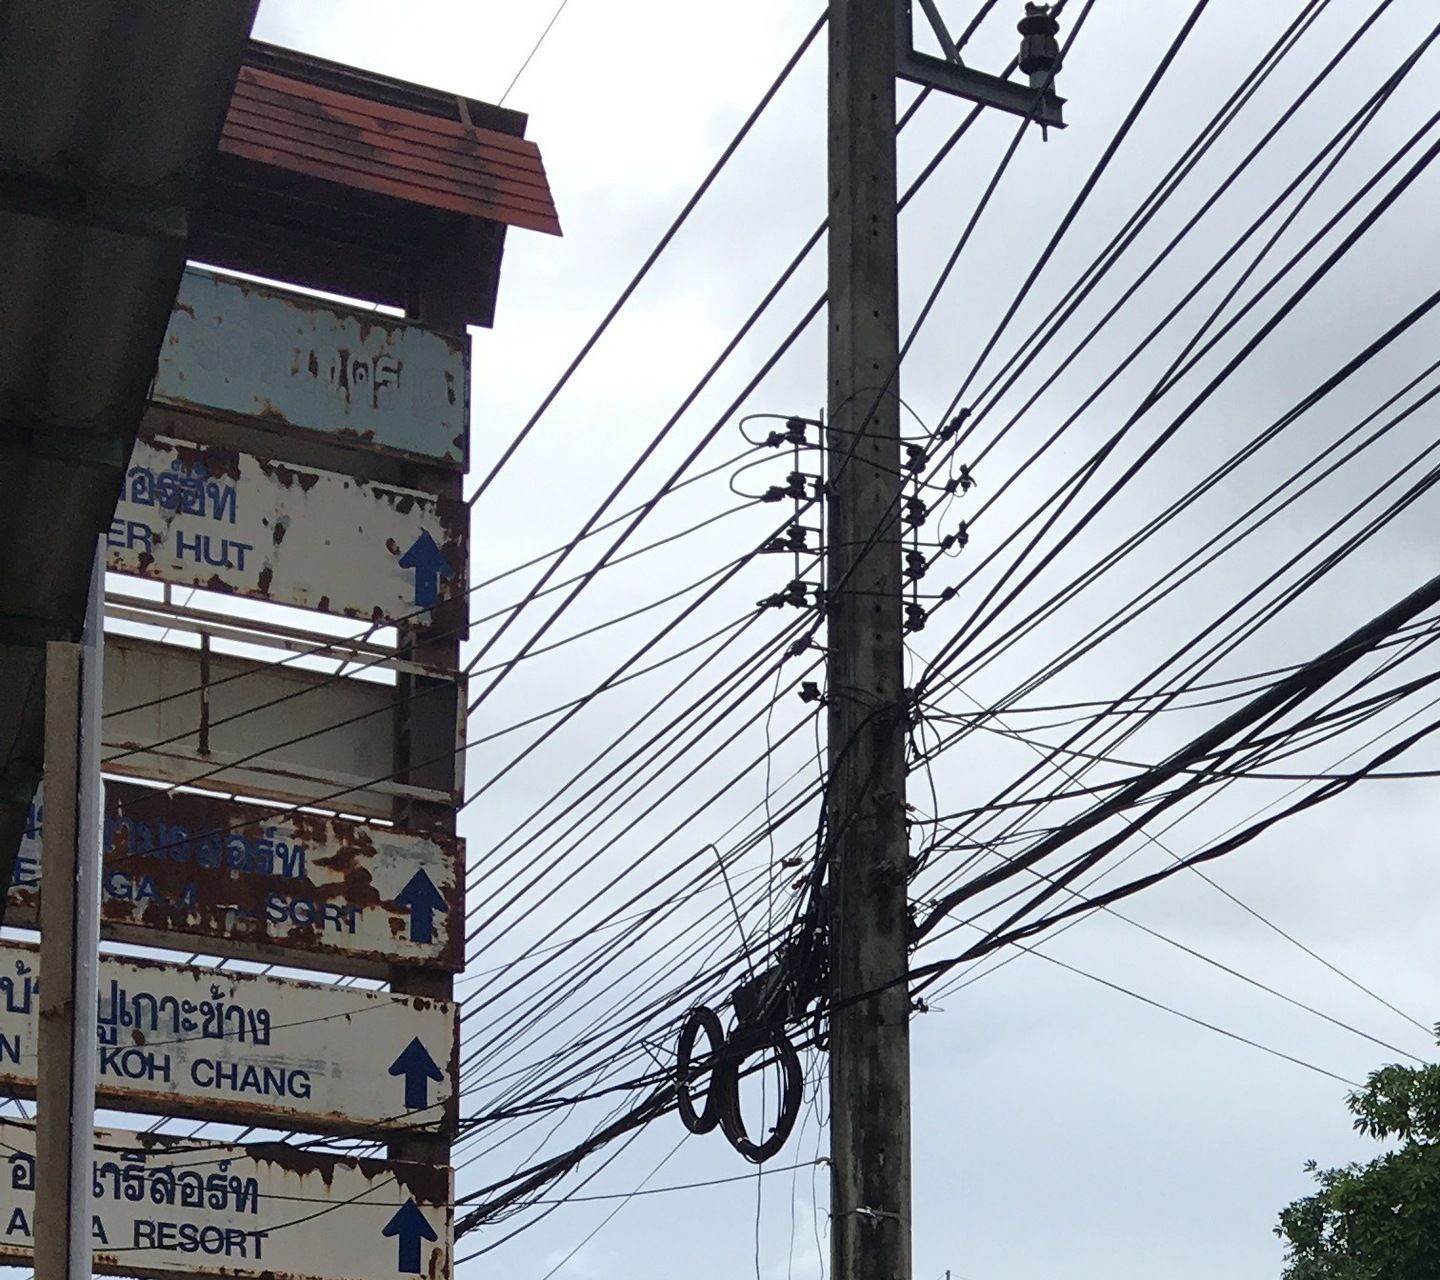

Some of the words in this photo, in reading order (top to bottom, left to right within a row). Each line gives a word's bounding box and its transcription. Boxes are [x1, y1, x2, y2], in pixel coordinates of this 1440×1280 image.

[176, 530, 253, 571] HUT
[101, 1046, 171, 1083] KOH
[191, 1058, 312, 1100] CHANG
[133, 1219, 269, 1260] RESORT
